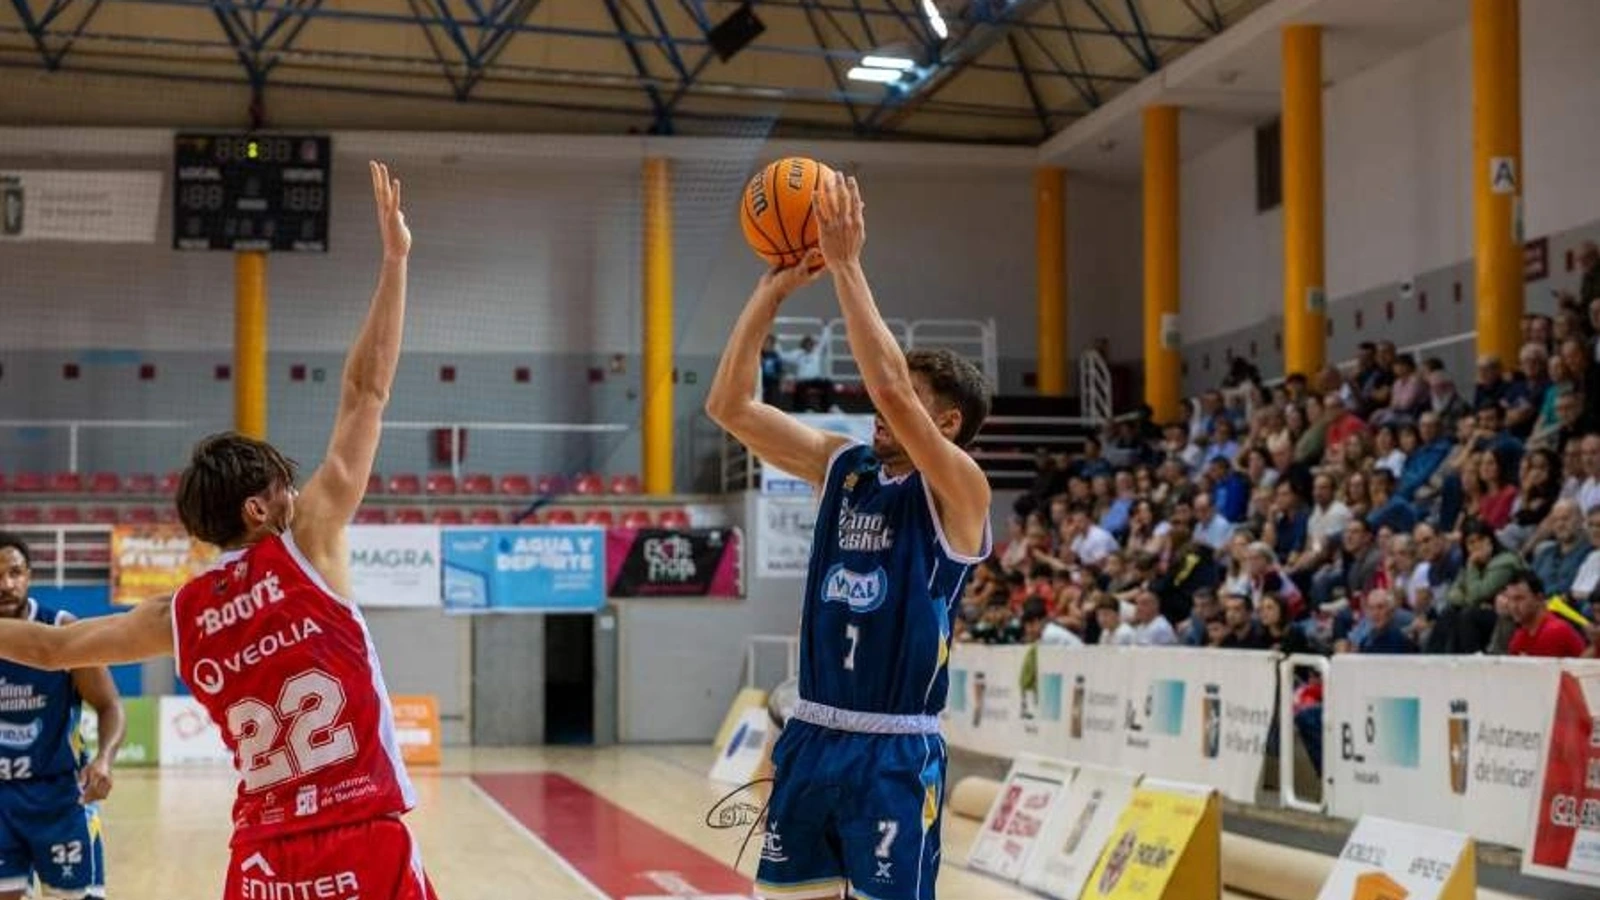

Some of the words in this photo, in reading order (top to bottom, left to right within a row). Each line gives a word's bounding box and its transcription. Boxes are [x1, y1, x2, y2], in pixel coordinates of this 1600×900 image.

[1493, 161, 1515, 186] A
[577, 536, 594, 552] Y
[224, 616, 323, 673] VEOLIA
[226, 667, 359, 794] 22
[0, 756, 32, 780] 32
[875, 820, 897, 858] 7
[51, 841, 82, 864] 32
